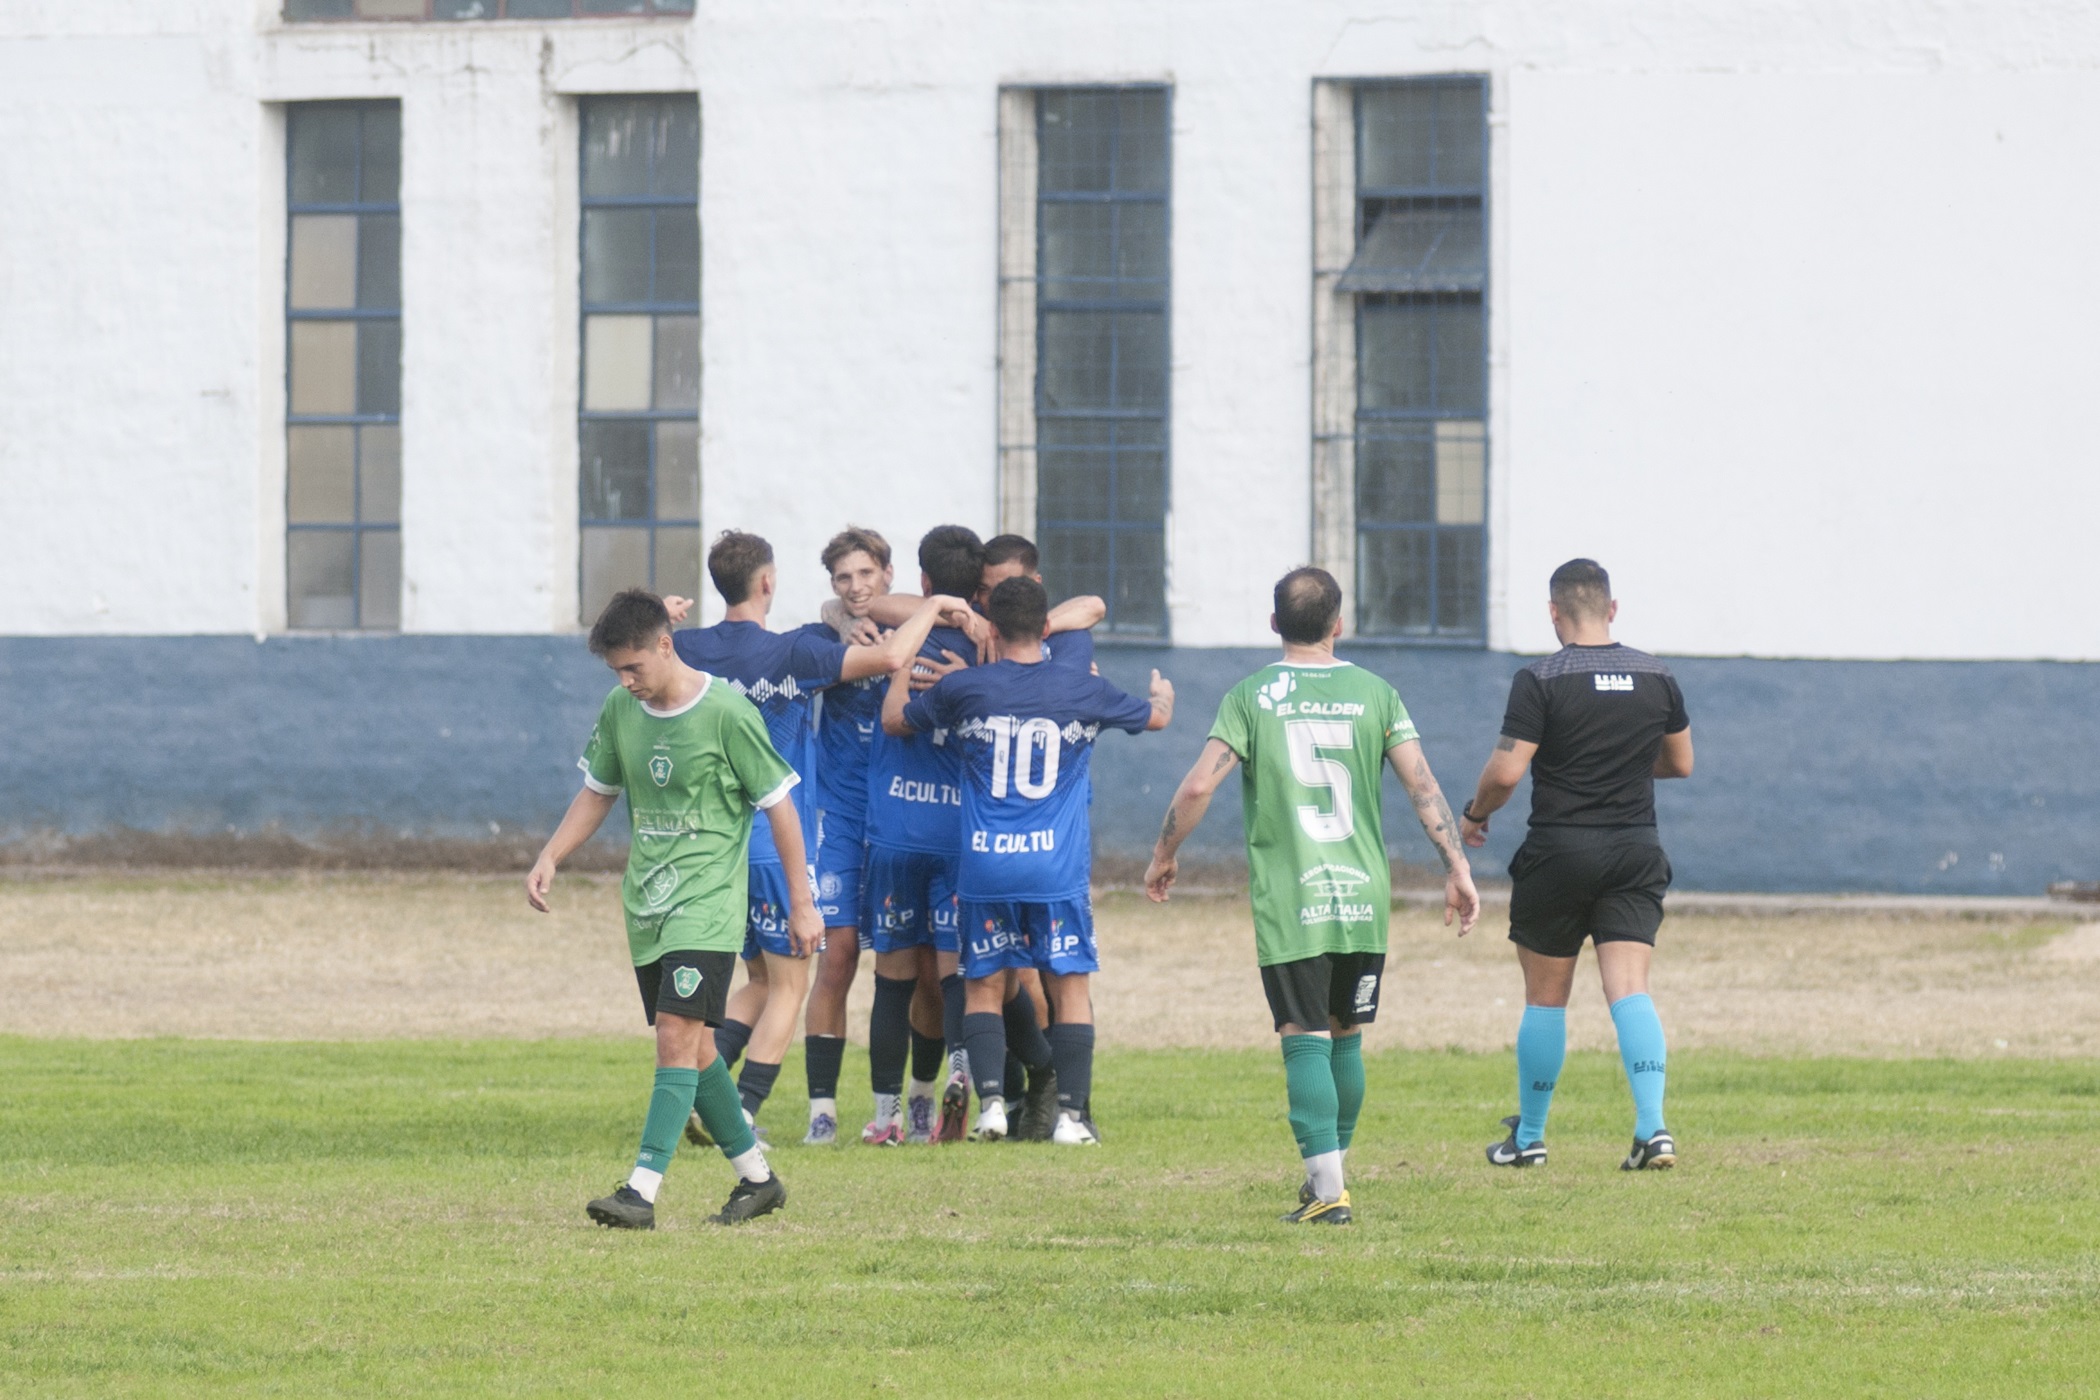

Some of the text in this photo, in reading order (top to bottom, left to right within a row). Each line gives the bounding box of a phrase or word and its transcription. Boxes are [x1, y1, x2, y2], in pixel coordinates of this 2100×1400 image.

[1276, 701, 1365, 717] EL CALDEN
[984, 715, 1061, 799] 10
[889, 776, 961, 806] EL CULTU
[1284, 719, 1354, 842] 5
[972, 829, 1055, 854] EL CULTU
[1301, 904, 1373, 920] ALTA ITALIA
